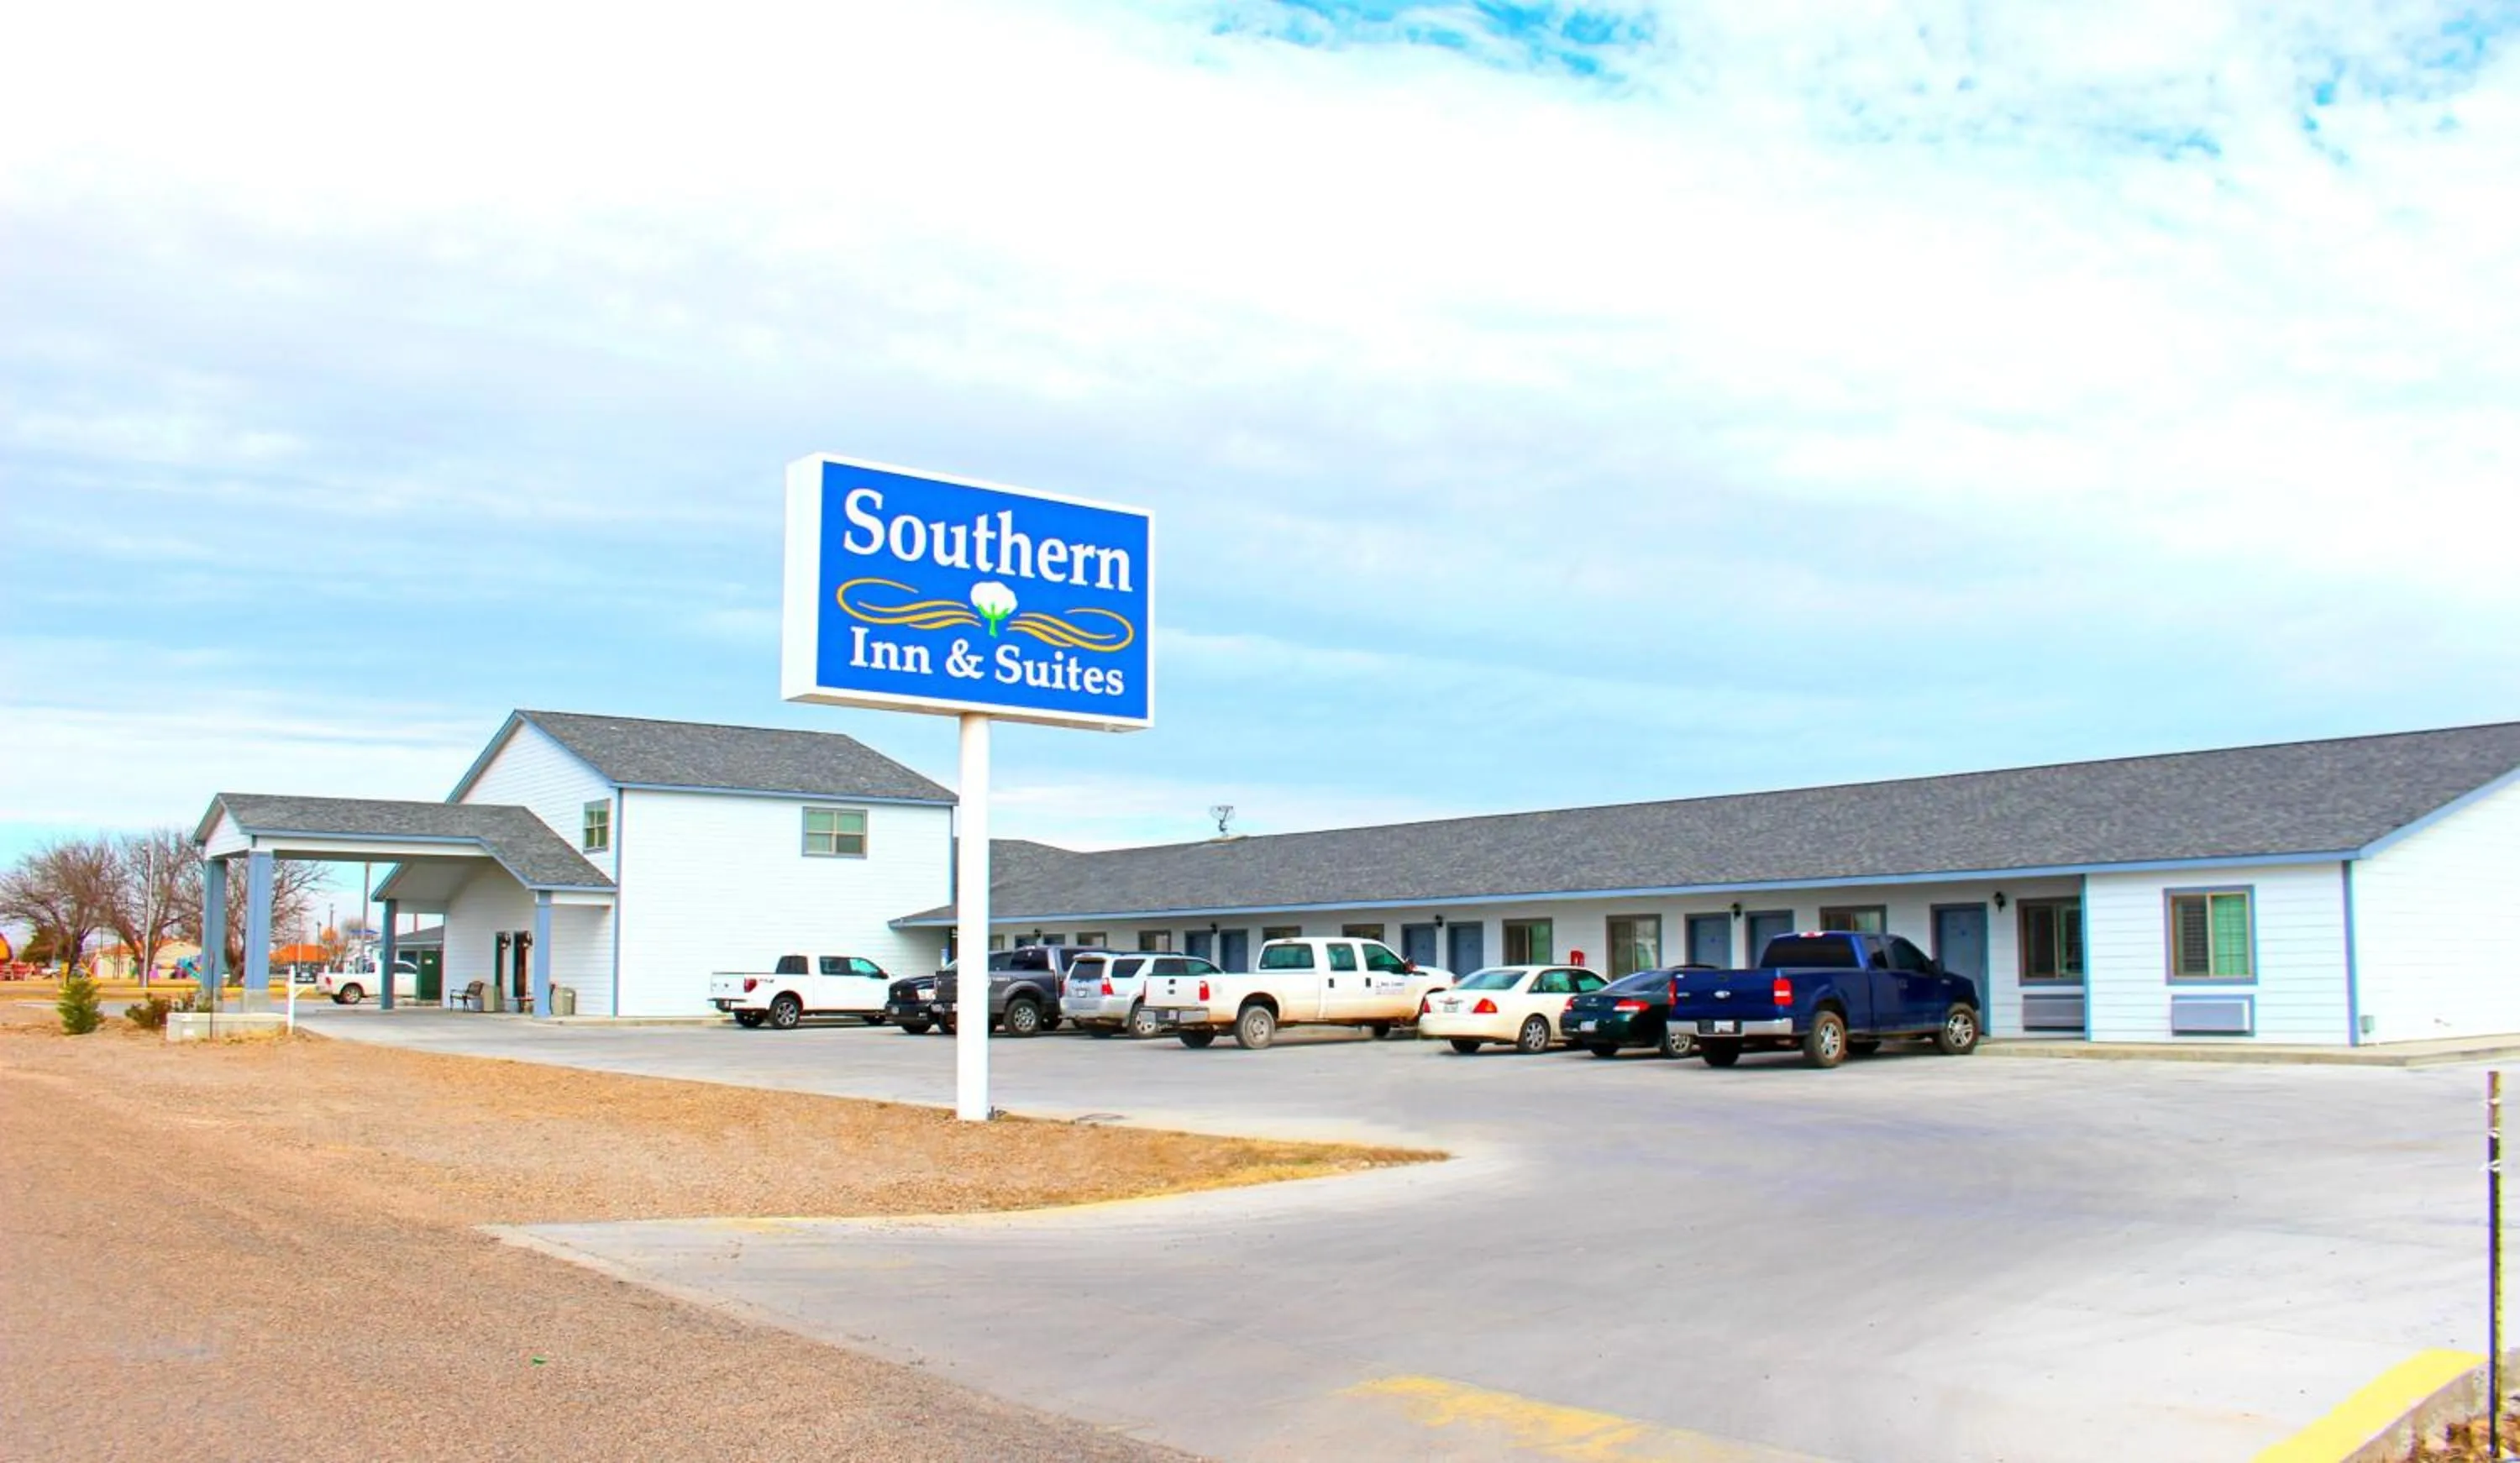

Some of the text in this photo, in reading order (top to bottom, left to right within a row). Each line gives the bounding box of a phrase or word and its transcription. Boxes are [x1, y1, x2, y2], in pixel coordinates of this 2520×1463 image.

[843, 488, 1133, 592] Southern
[850, 627, 1125, 695] Inn & Suites
